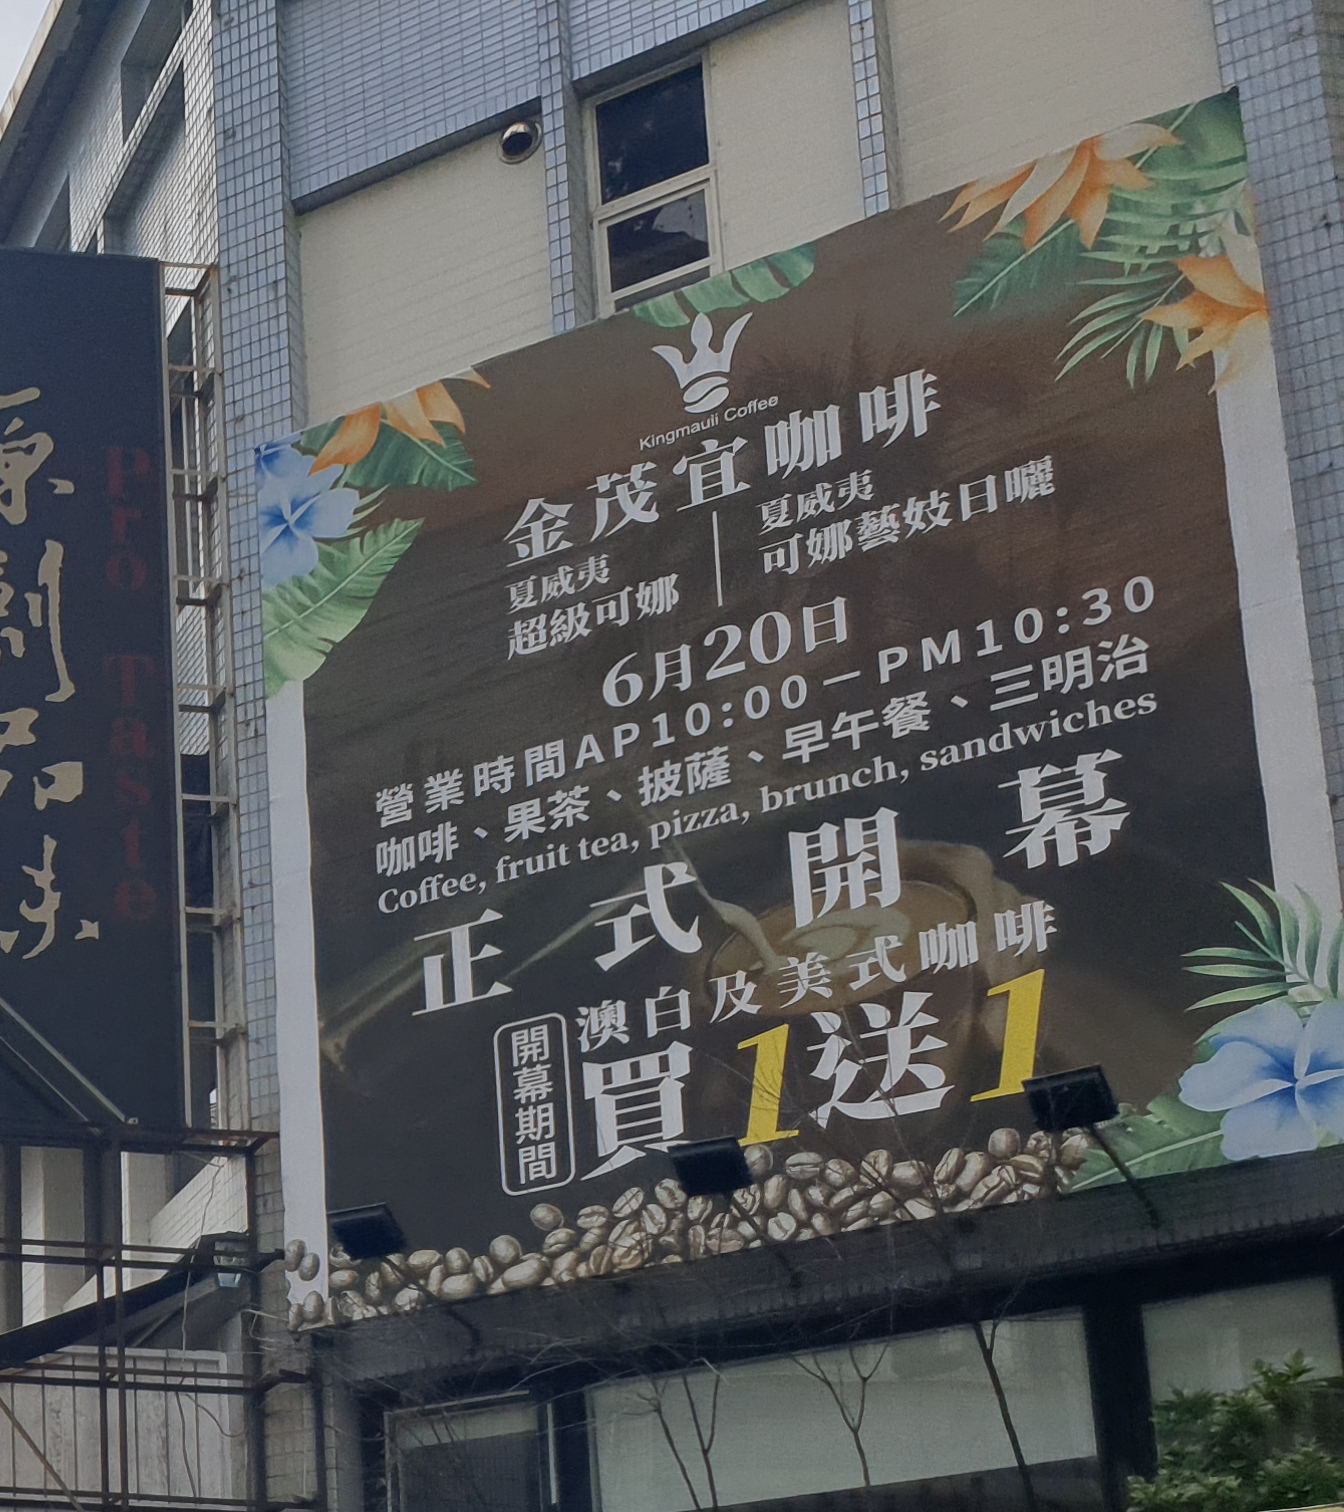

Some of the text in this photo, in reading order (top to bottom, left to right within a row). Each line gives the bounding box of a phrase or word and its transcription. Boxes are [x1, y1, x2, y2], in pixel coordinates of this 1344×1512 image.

[505, 369, 942, 567] 金茂宜咖啡
[724, 395, 779, 422] Coffee
[755, 470, 874, 533] 夏威夷
[757, 455, 1055, 575] 可娜藝妓日曬
[505, 555, 611, 614] 夏威夷
[507, 572, 681, 660] 超級可娜
[602, 596, 848, 707] 6月20日
[378, 691, 1157, 915] Coffee, fruit tea, pizza, brunch, sandwiches
[412, 749, 1130, 1016] 正式開幕
[576, 900, 1057, 1054] 澳白及美式咖啡
[511, 1023, 561, 1185] 開幕期間
[579, 968, 1047, 1182] 買1送1
